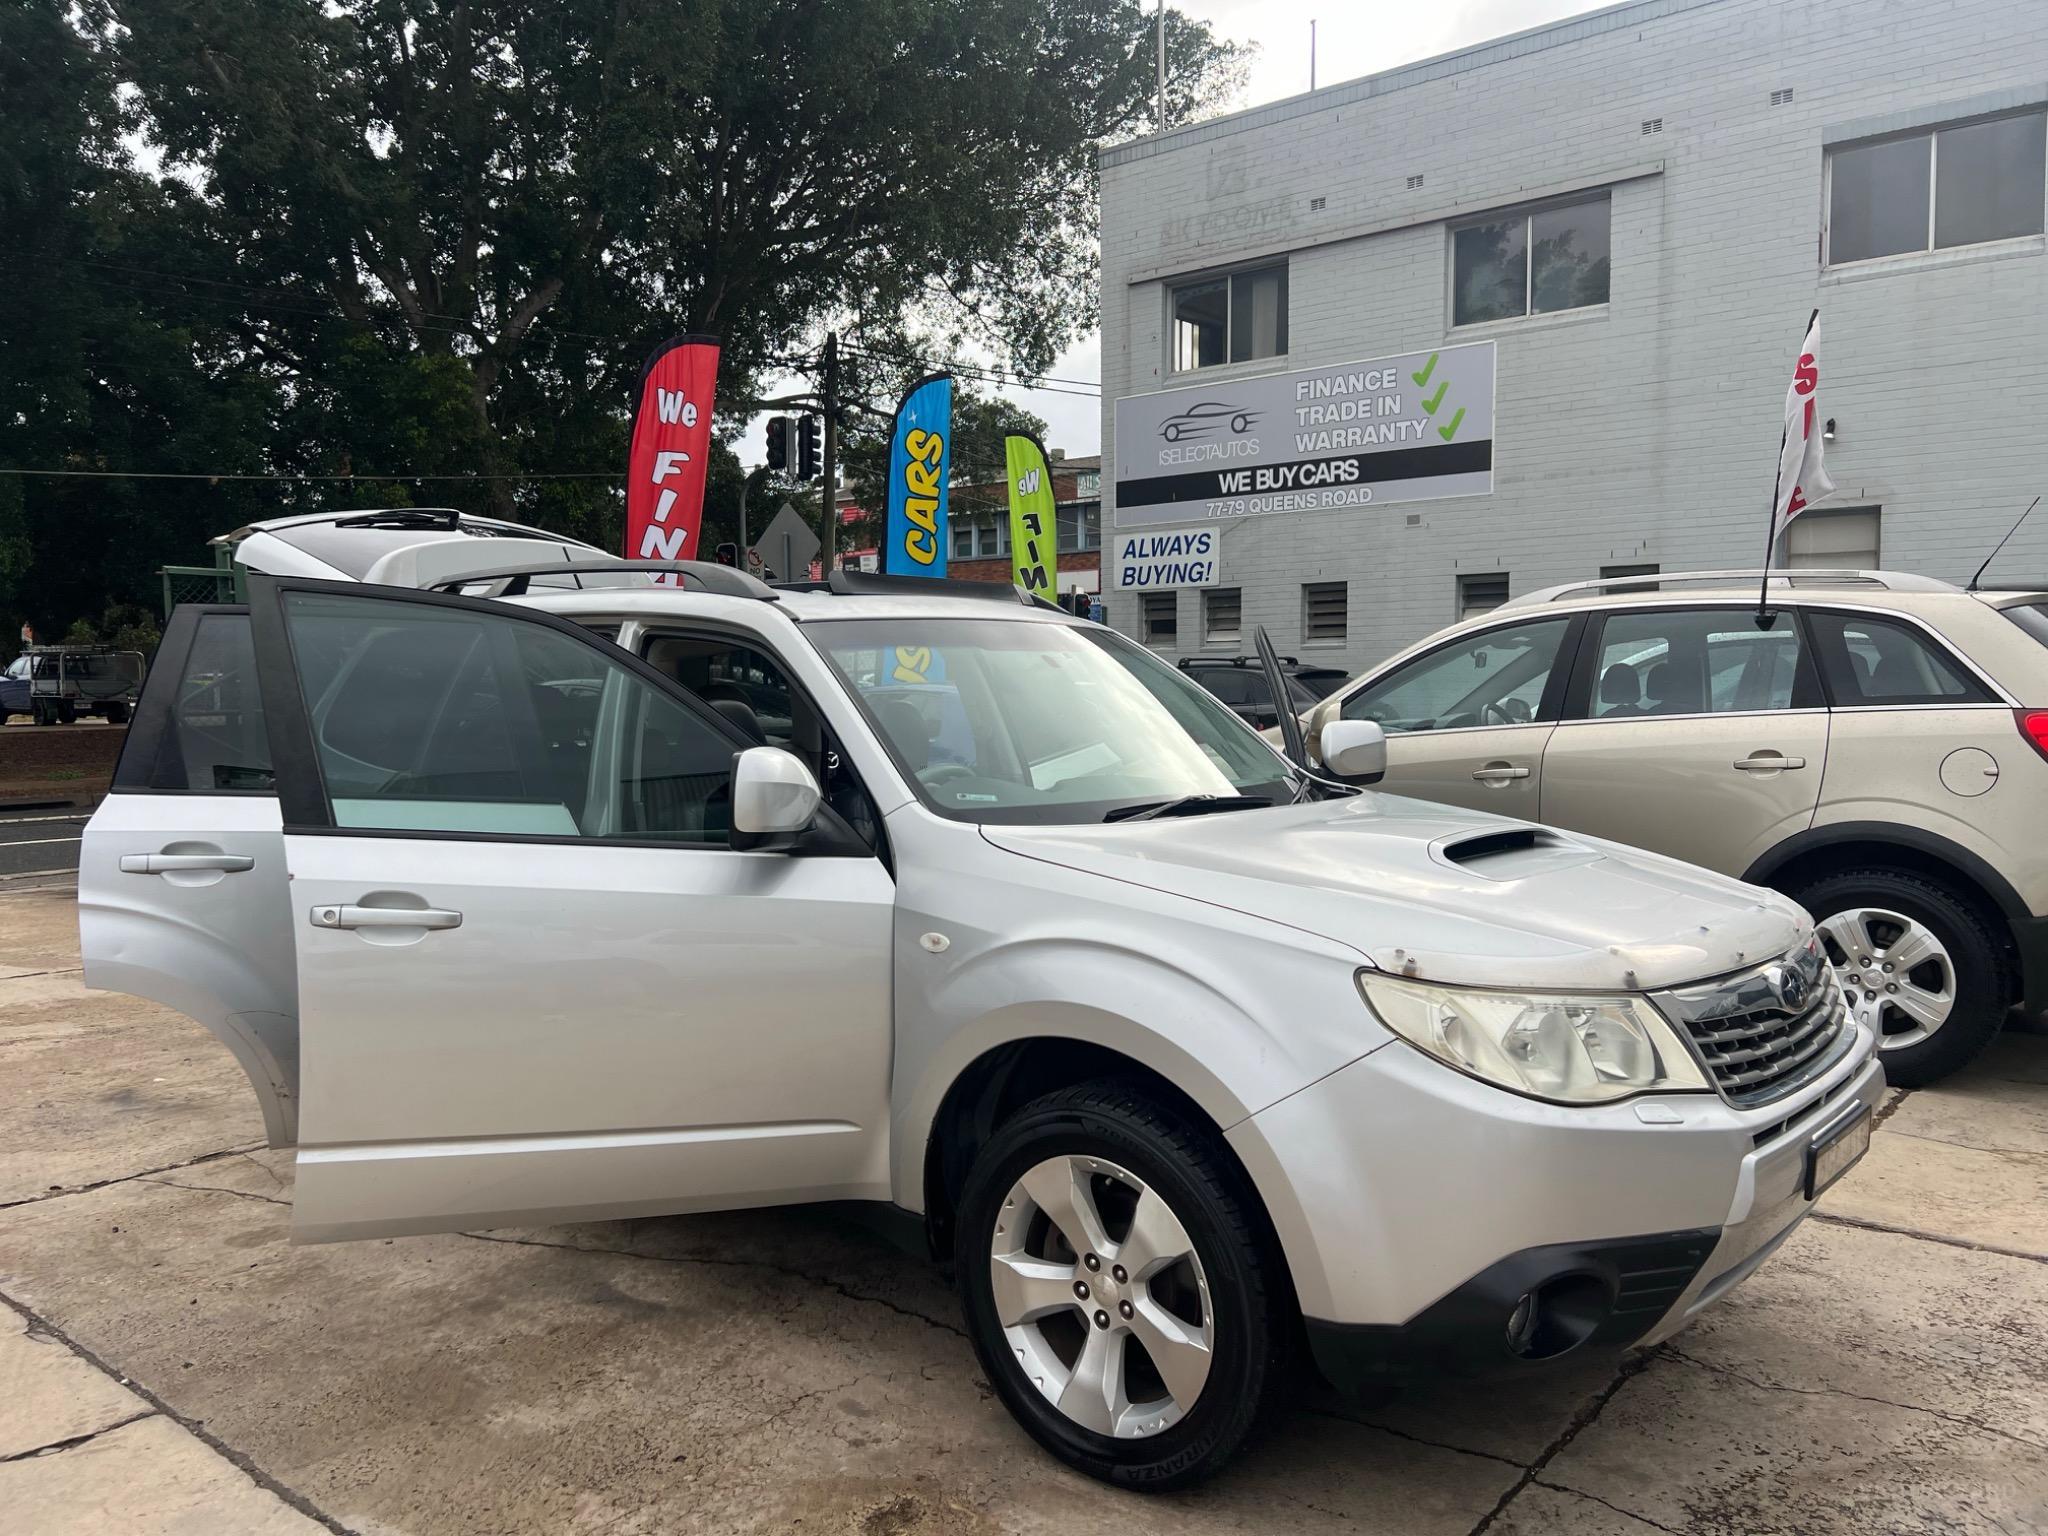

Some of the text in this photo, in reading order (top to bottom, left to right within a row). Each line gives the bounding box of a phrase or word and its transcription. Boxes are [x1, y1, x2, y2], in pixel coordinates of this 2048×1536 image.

[1296, 368, 1397, 401] FINANCE
[657, 387, 698, 428] We
[1295, 394, 1401, 427] TRADE IN
[1294, 417, 1429, 453] WARRANTY
[1218, 459, 1359, 494] WE BUY CARS
[904, 427, 944, 566] CARS
[1206, 488, 1373, 518] 77-79 QUEENS ROAD
[1122, 533, 1211, 559] ALWAYS
[1122, 562, 1212, 586] BUYING!
